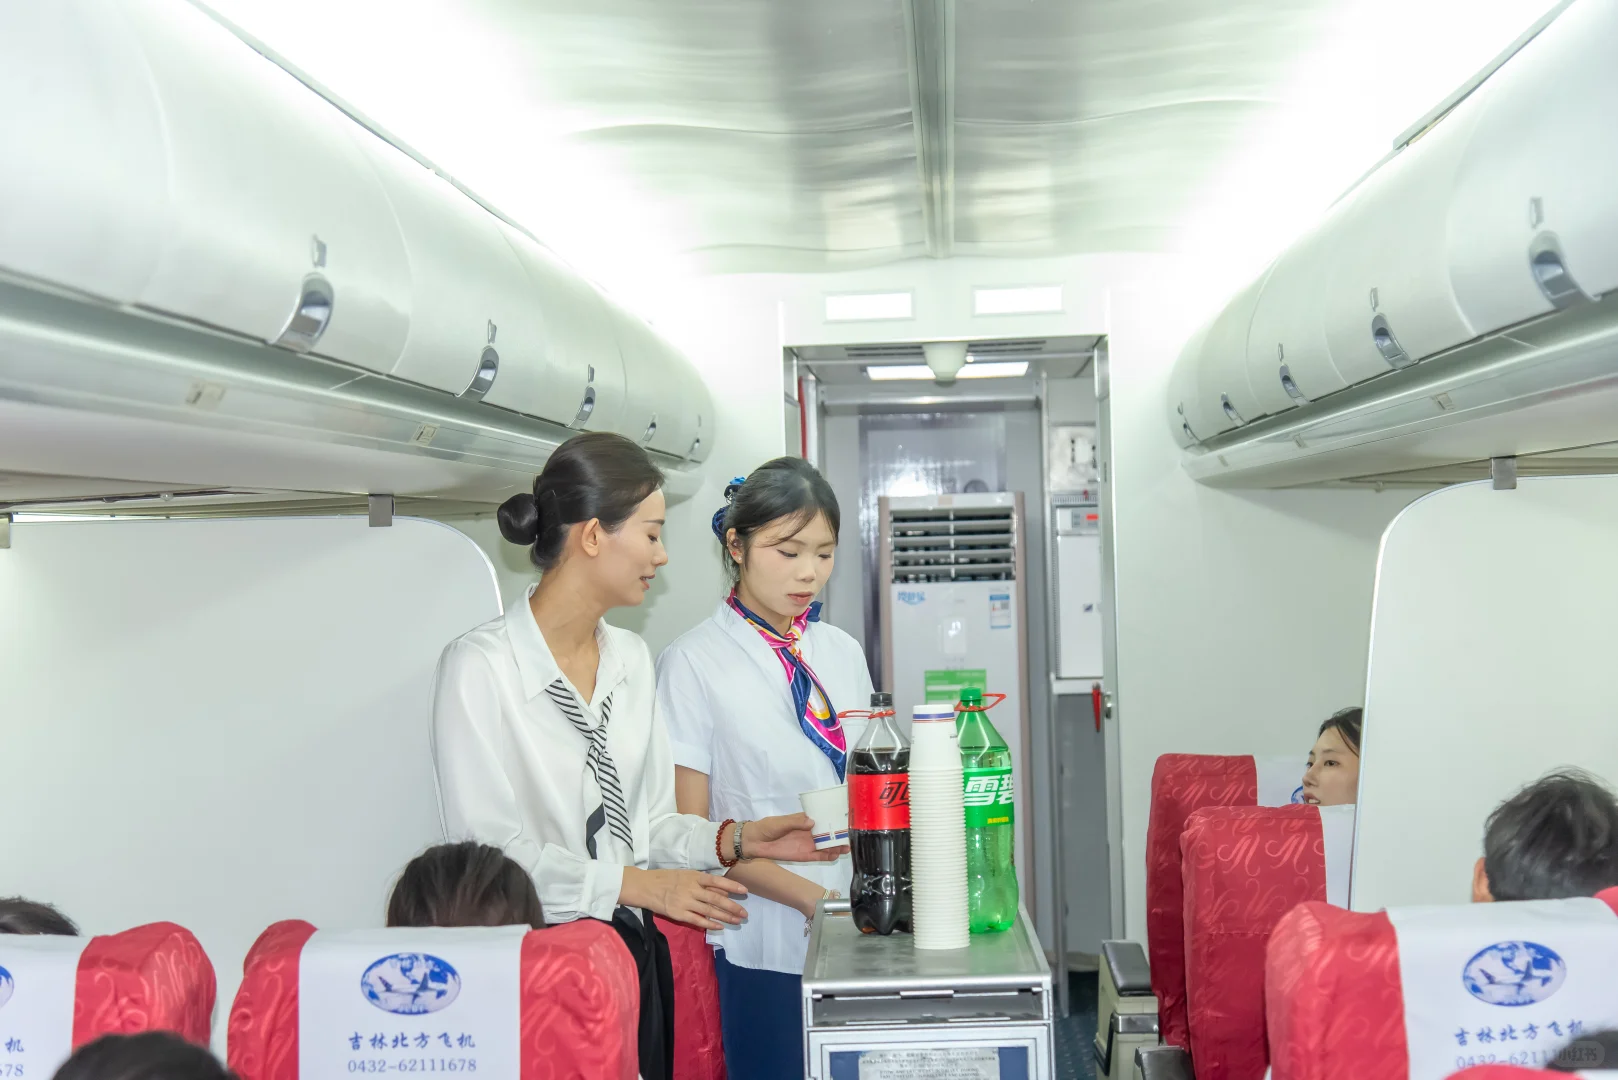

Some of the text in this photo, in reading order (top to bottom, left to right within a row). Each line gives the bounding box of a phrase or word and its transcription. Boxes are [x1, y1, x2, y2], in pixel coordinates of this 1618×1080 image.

[349, 1031, 476, 1051] 吉林北方飞机
[1455, 1019, 1583, 1046] 吉林北方飞机
[348, 1058, 477, 1073] 0432-62111678
